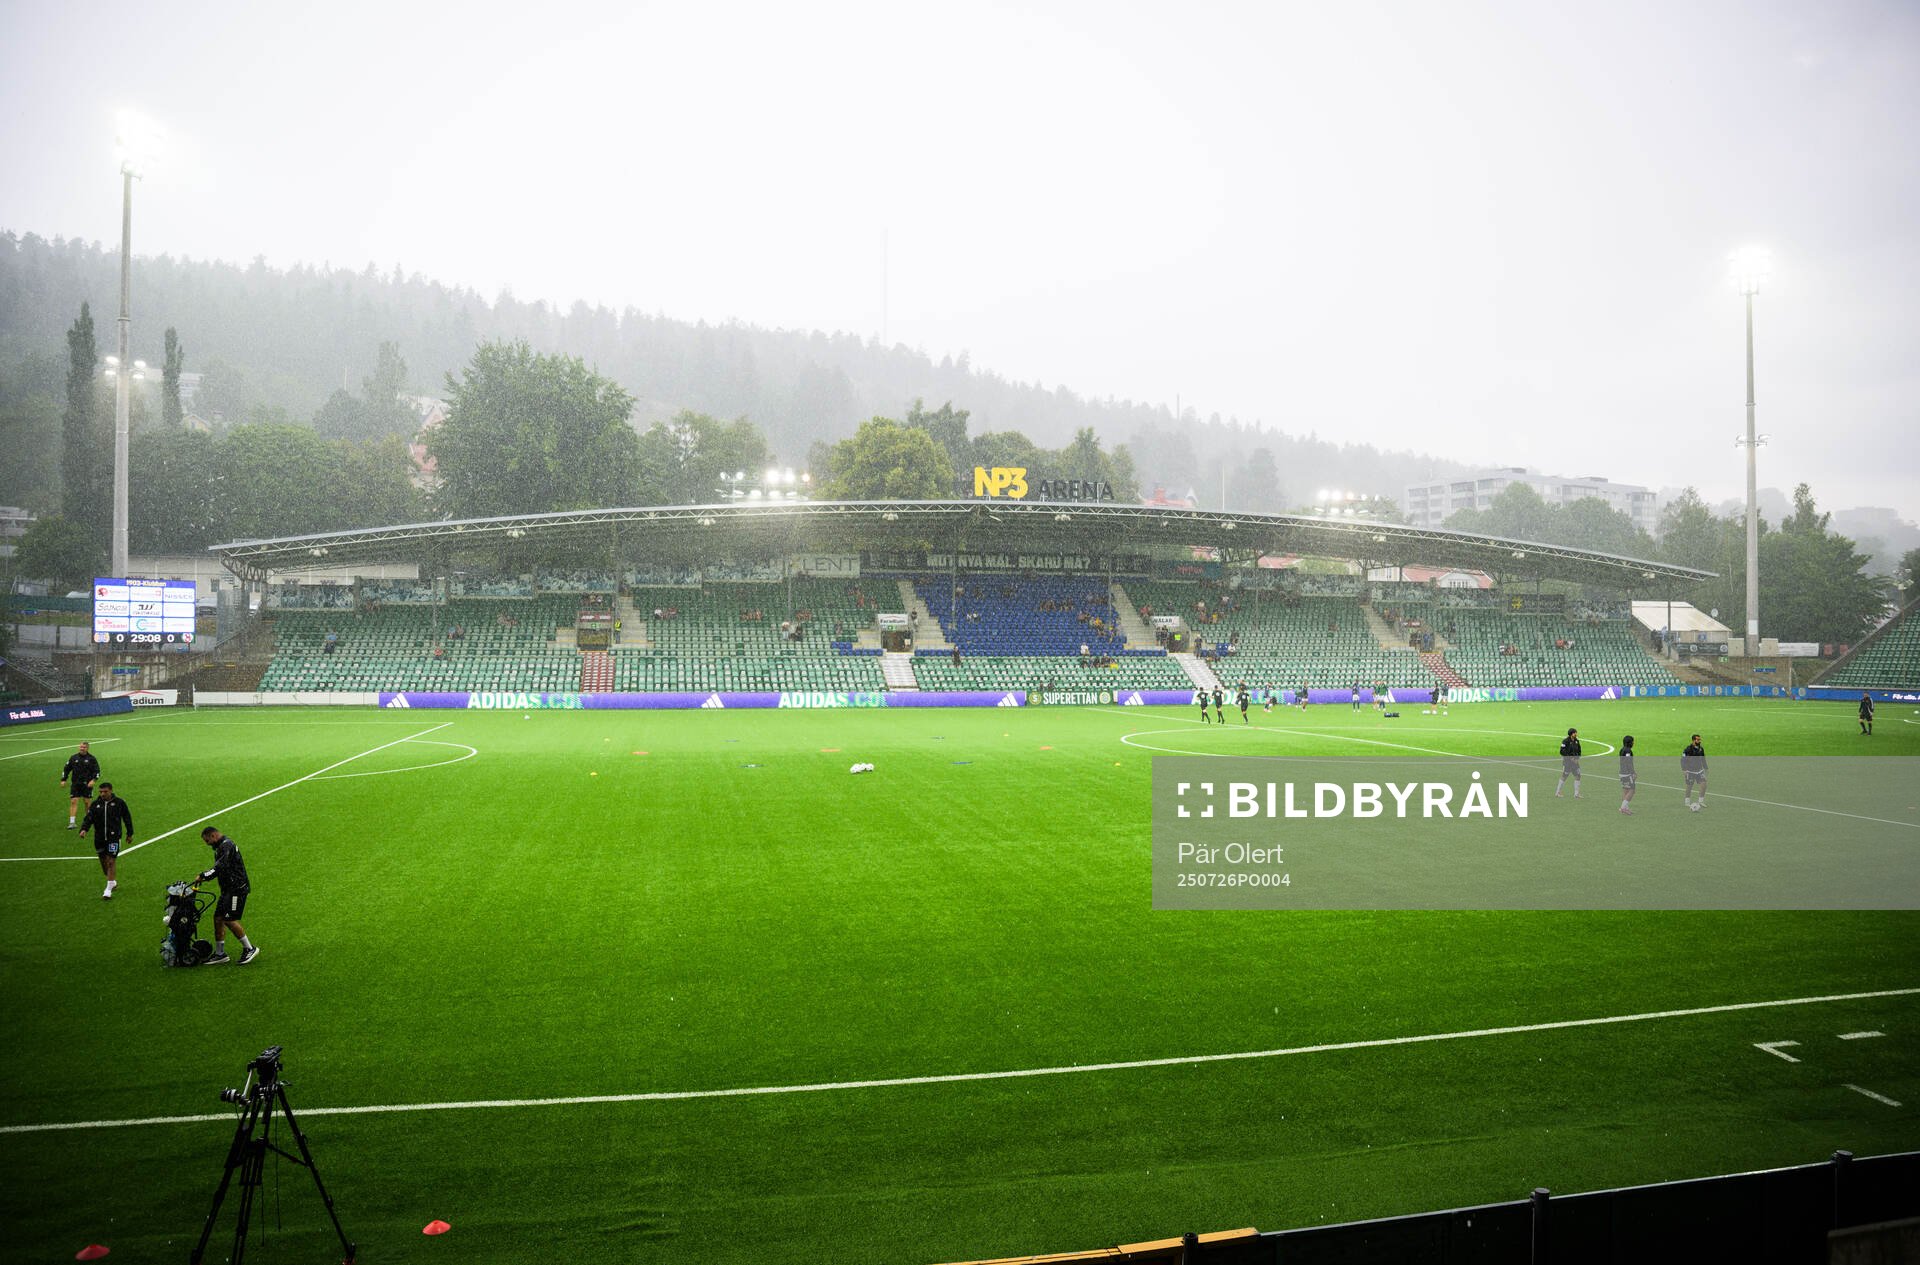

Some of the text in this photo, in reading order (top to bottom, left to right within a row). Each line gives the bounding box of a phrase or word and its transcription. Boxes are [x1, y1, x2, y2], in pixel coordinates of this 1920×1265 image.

[974, 466, 1115, 500] NP3 ARENA
[958, 555, 983, 567] NYA
[116, 634, 175, 642] 0 29:08 0
[1043, 692, 1098, 704] SUPERETTAN
